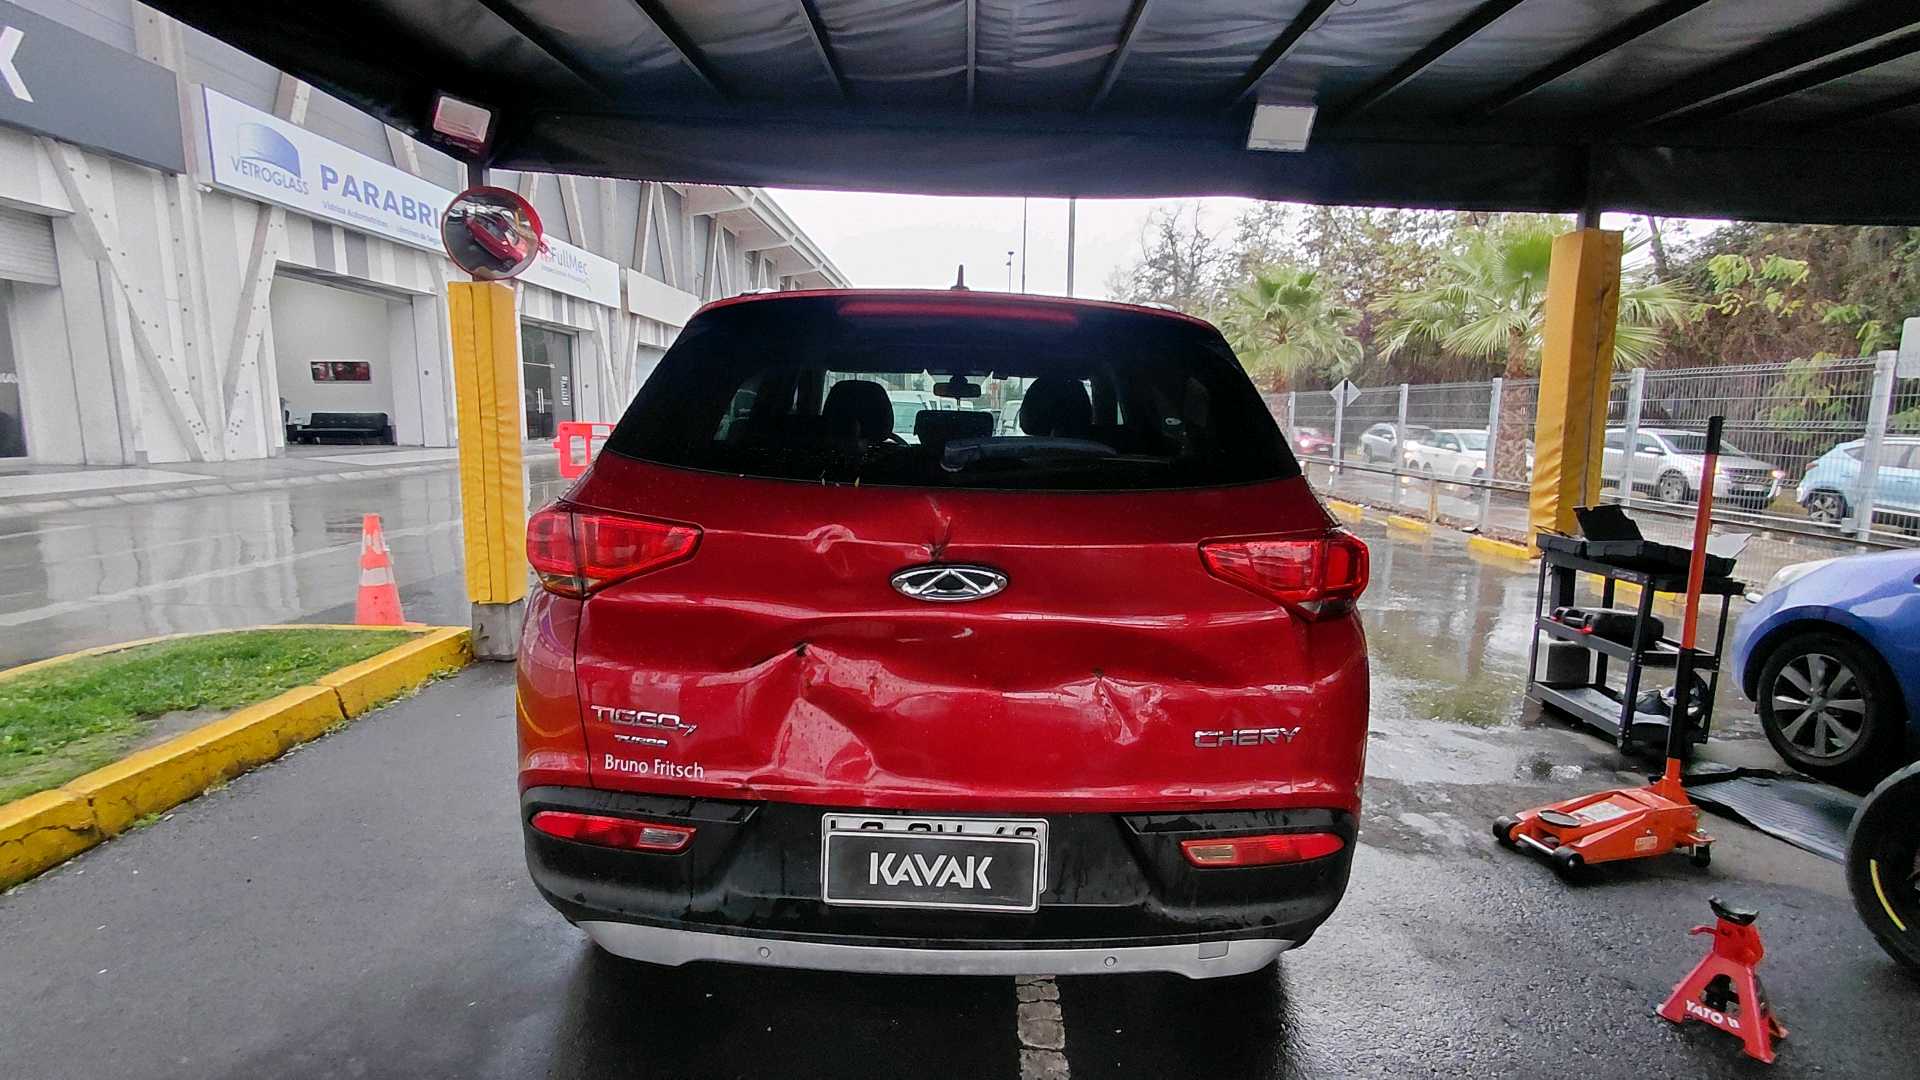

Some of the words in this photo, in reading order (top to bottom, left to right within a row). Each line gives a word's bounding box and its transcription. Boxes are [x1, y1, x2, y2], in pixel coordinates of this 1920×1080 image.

[231, 156, 309, 195] VETROGLASS
[319, 164, 442, 230] PARABRI
[1194, 726, 1301, 748] CHERY
[604, 754, 649, 774] Bruno
[654, 759, 704, 779] Fritsch
[869, 852, 993, 889] KAVAK
[1686, 1000, 1723, 1024] YATO
